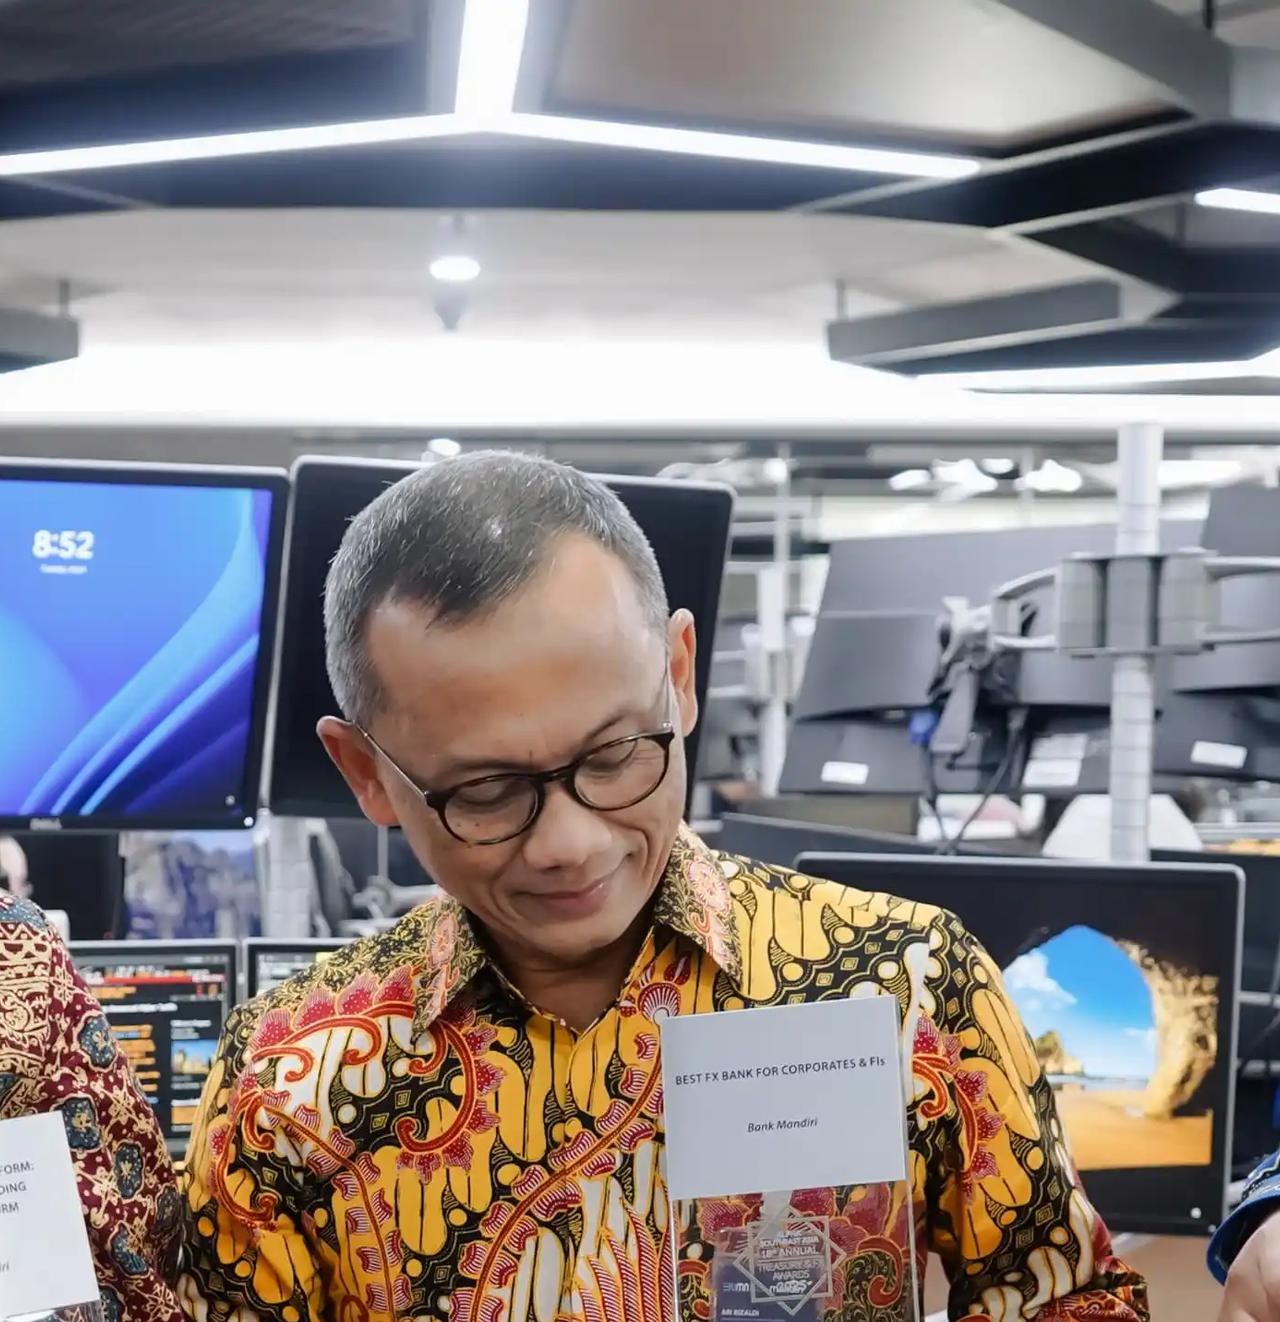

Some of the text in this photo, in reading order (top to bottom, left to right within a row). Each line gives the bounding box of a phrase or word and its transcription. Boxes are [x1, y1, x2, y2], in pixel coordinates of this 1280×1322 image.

[32, 529, 94, 560] 8:52
[675, 1056, 885, 1086] BEST FX BANK FOR CORPORATES & FIs
[747, 1117, 818, 1133] Bank Mandiri
[779, 1247, 819, 1257] ANNUAL
